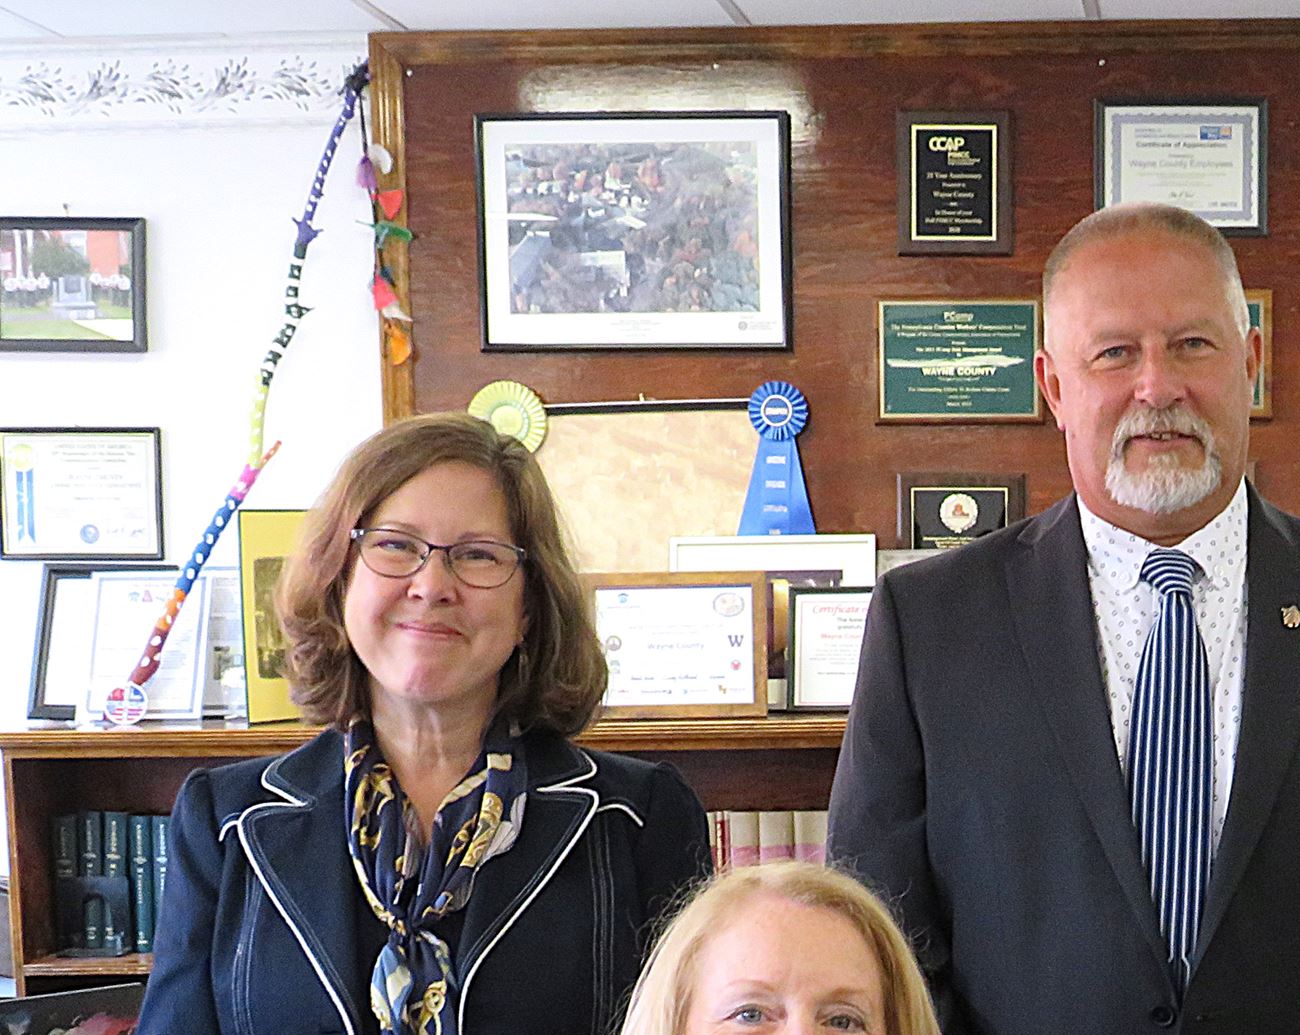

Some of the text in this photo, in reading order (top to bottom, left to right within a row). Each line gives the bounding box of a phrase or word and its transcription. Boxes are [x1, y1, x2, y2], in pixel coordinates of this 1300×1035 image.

[928, 136, 965, 152] CCAP
[1129, 159, 1158, 169] Wayne
[1158, 159, 1188, 169] County
[921, 367, 997, 376] WAYNE COUNTY
[812, 604, 860, 616] Certificate
[647, 642, 706, 651] Wayne County
[727, 634, 744, 648] W
